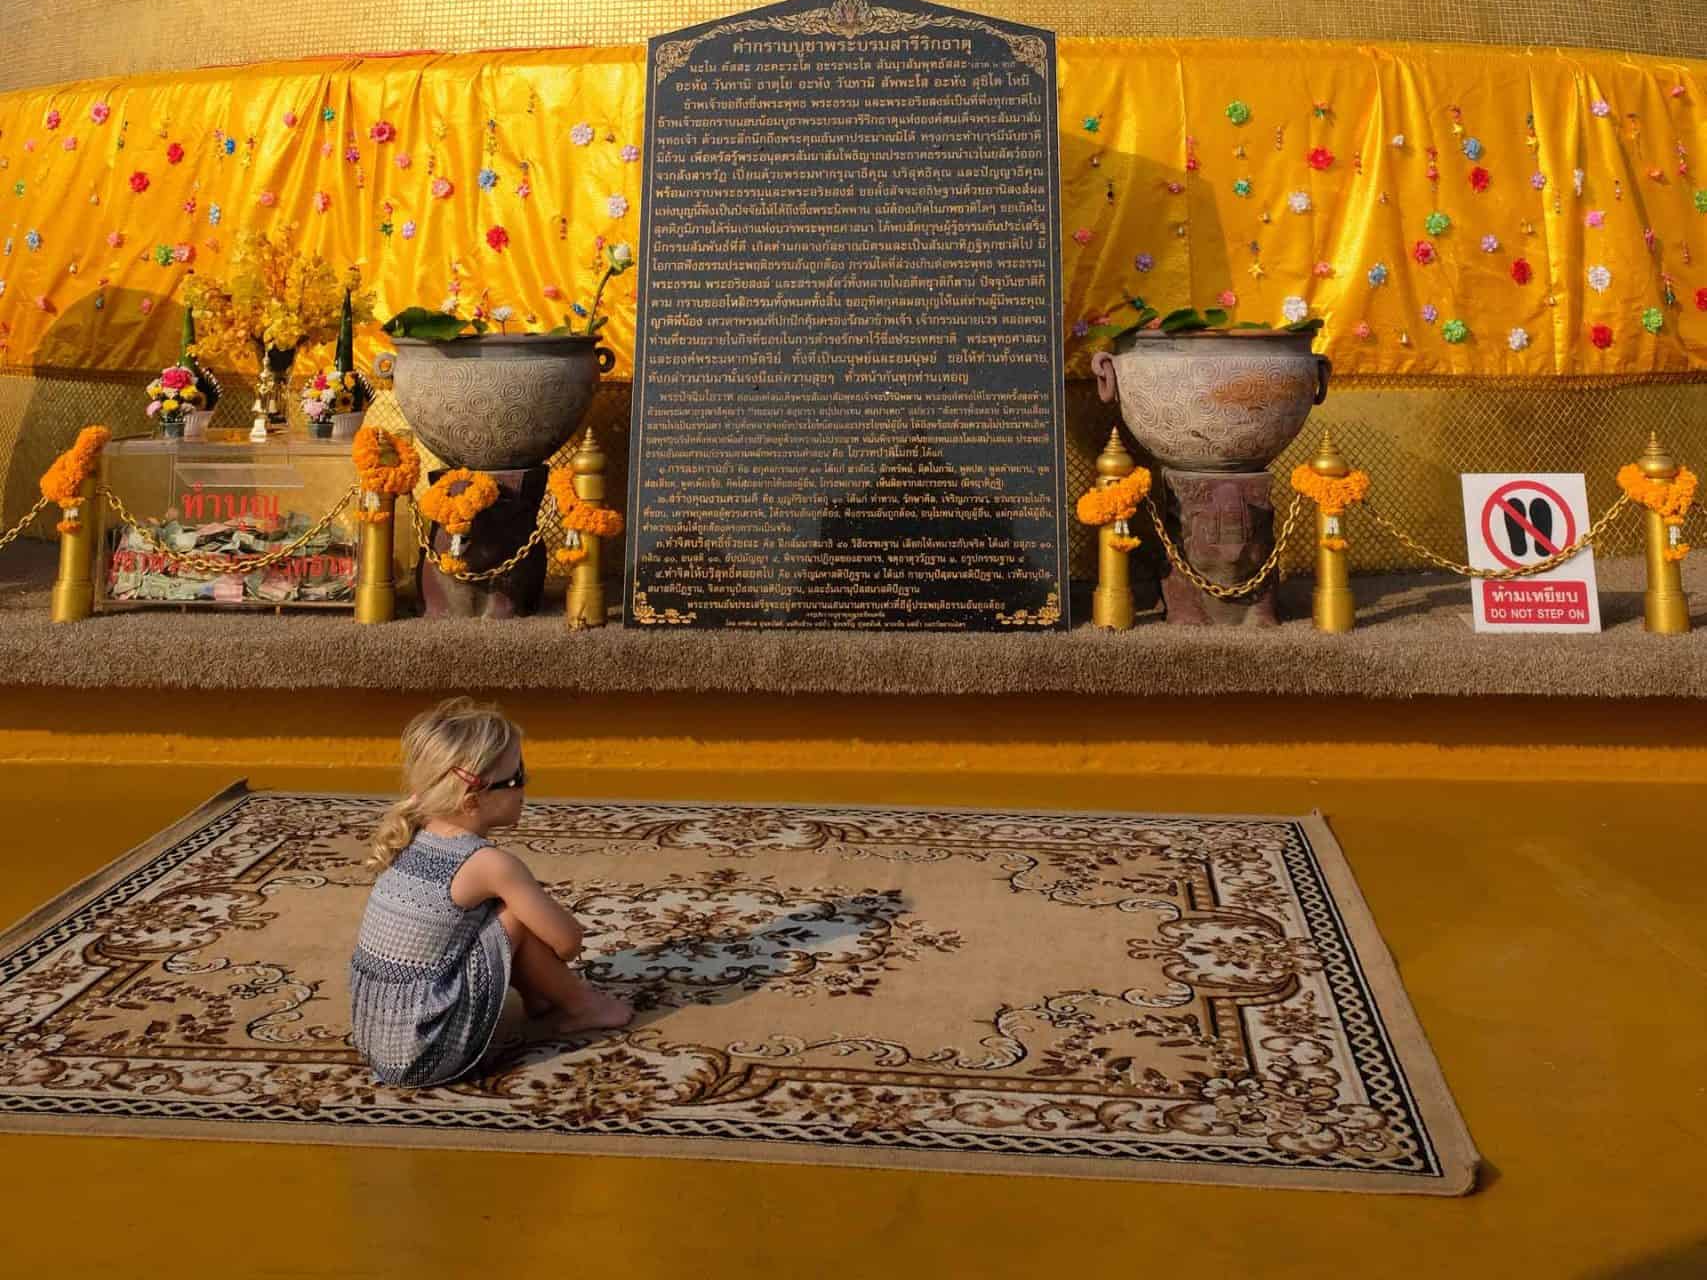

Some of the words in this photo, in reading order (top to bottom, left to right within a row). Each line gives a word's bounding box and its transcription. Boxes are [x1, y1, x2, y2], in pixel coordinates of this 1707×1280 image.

[733, 35, 972, 56] คำกราบบูชาพระบรมสารีริกธาตุ
[811, 98, 860, 108] พระธรรม
[181, 481, 280, 532] ทำบุญ
[1491, 585, 1579, 603] ห้ามเหยียบ
[1491, 608, 1507, 619] DO
[1511, 608, 1532, 619] NOT
[1537, 608, 1564, 619] STEP
[1568, 608, 1585, 620] ON
